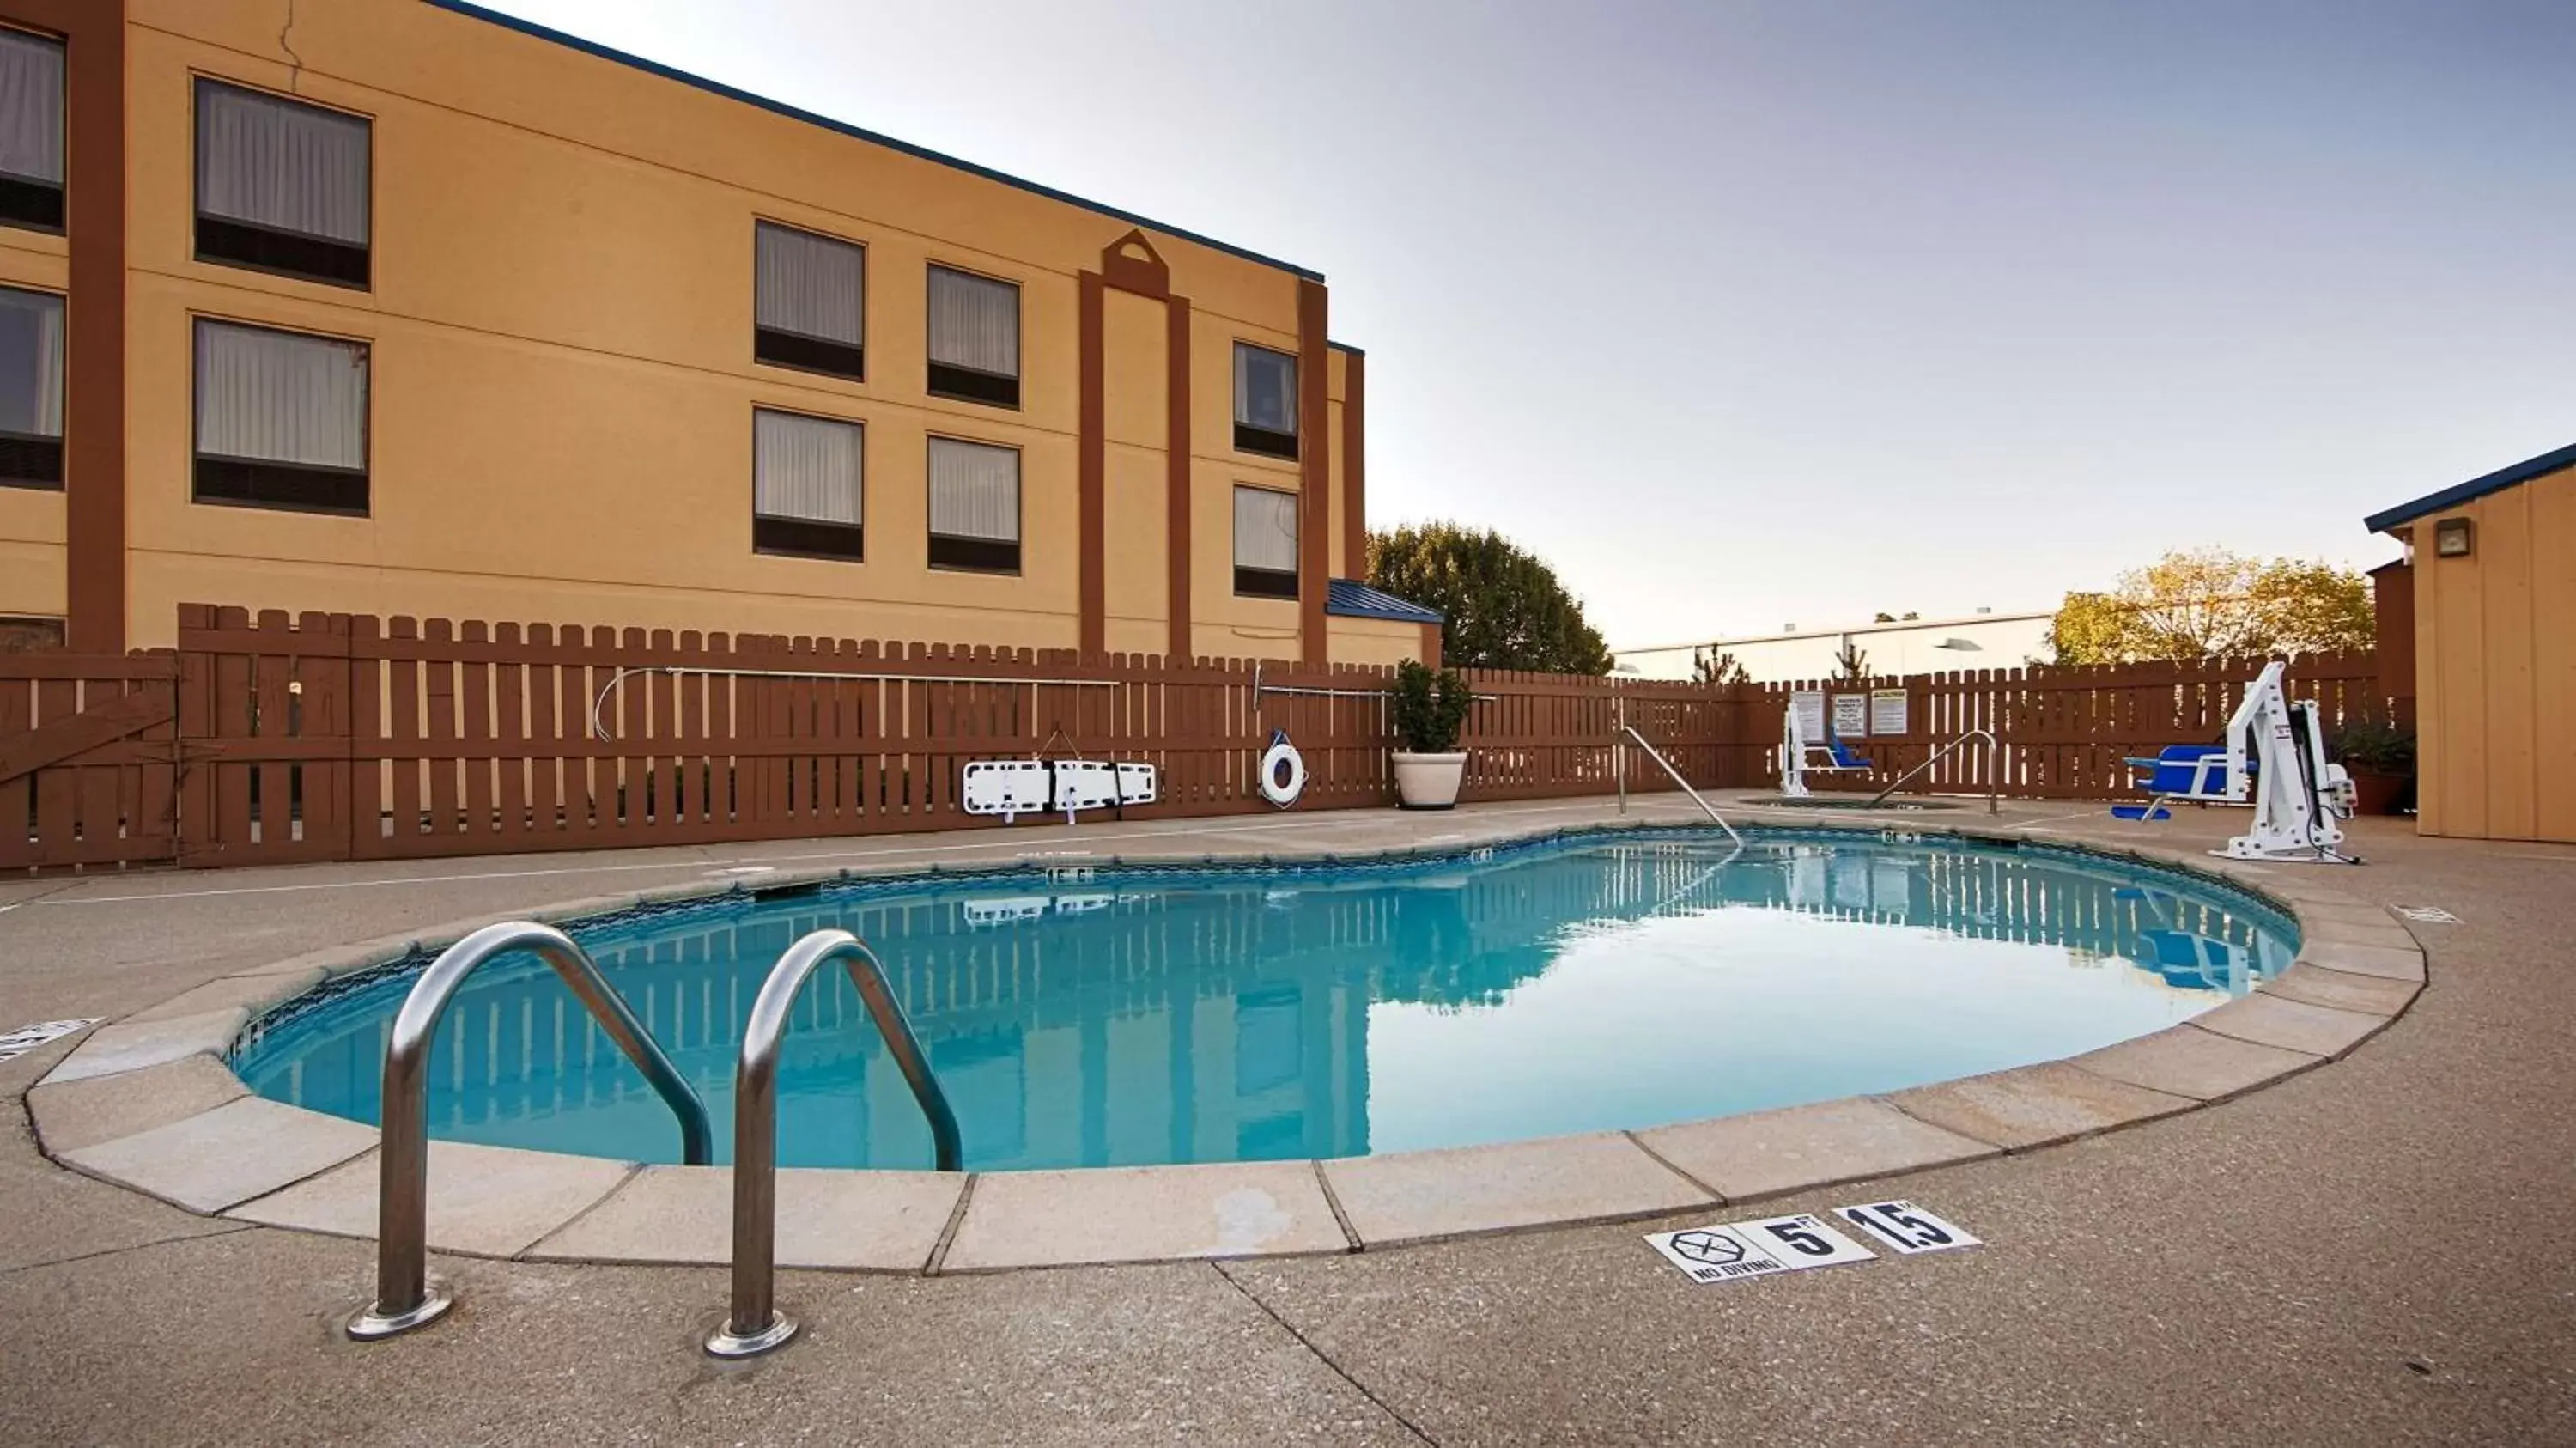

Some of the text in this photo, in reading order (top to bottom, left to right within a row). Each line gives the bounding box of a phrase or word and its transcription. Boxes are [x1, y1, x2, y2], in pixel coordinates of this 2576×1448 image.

[1765, 1222, 1835, 1256] 5
[1847, 1204, 1953, 1249] 1.5
[1693, 1259, 1781, 1280] NO DIVING
